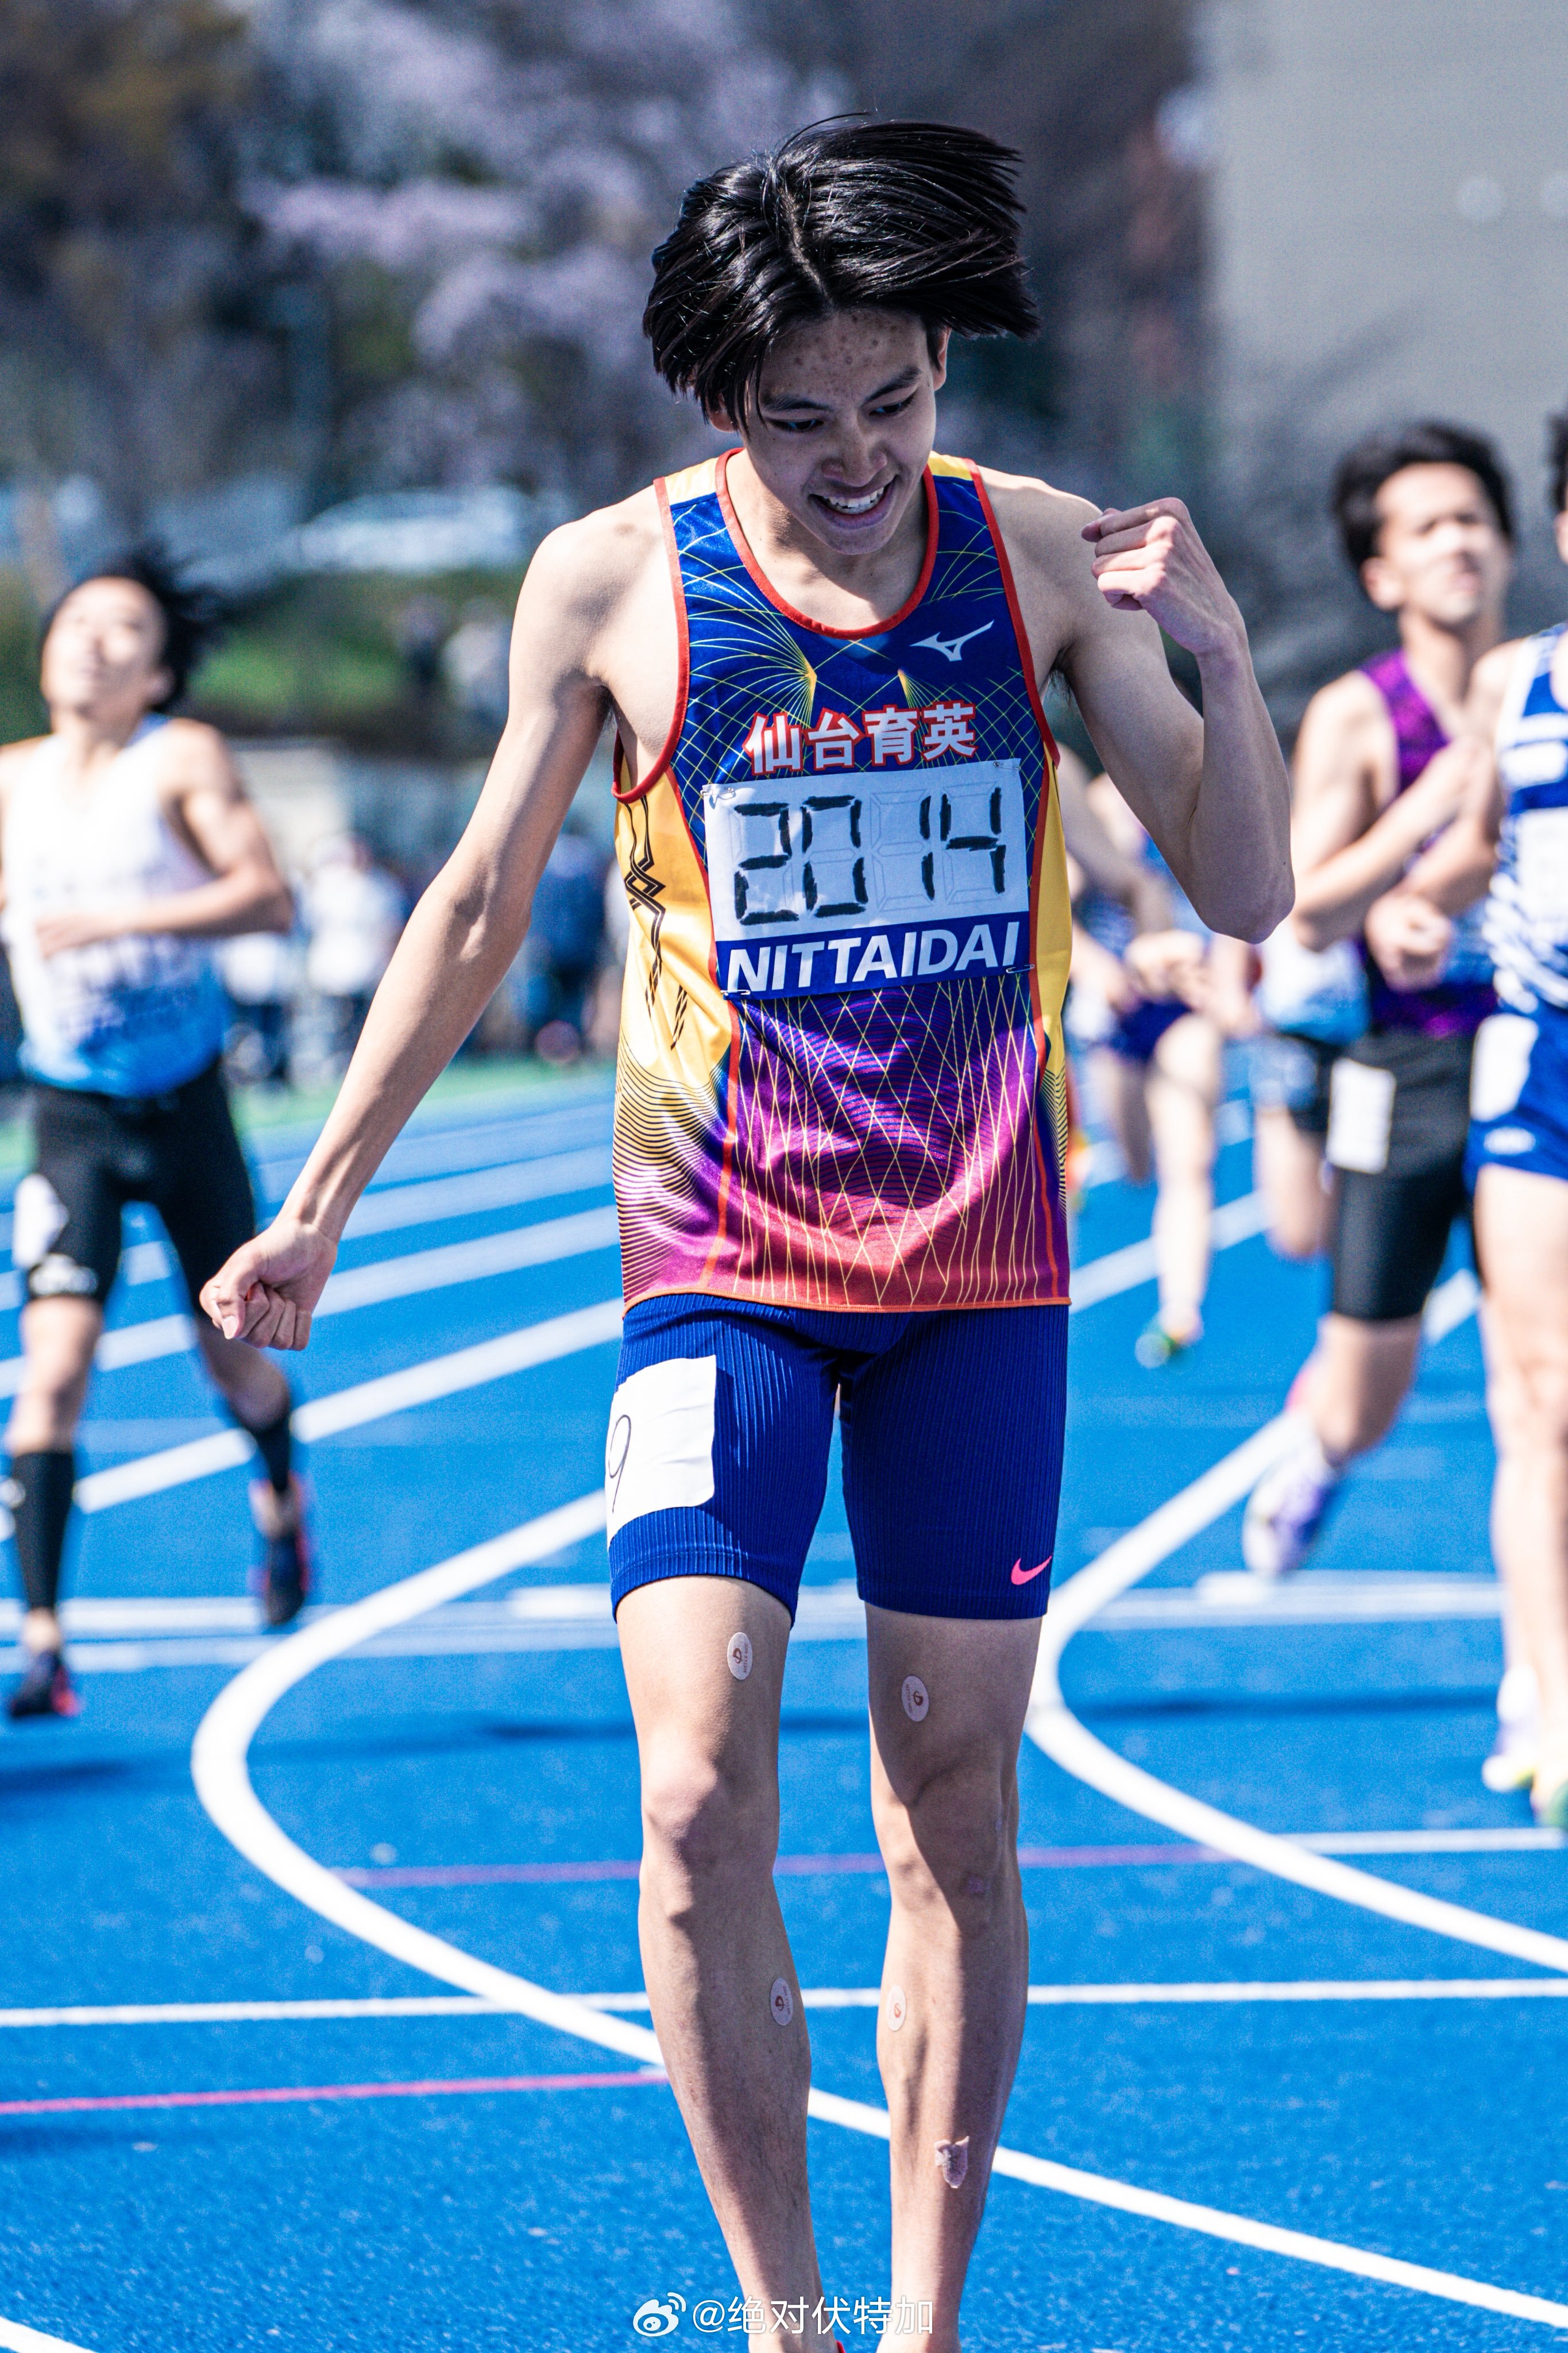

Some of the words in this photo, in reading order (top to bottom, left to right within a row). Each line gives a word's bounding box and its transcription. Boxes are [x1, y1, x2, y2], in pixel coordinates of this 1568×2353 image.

[744, 700, 978, 775] 仙台育英
[733, 786, 1006, 925] 2014
[727, 921, 1019, 993] NITTAIDAI
[608, 1414, 631, 1514] 9
